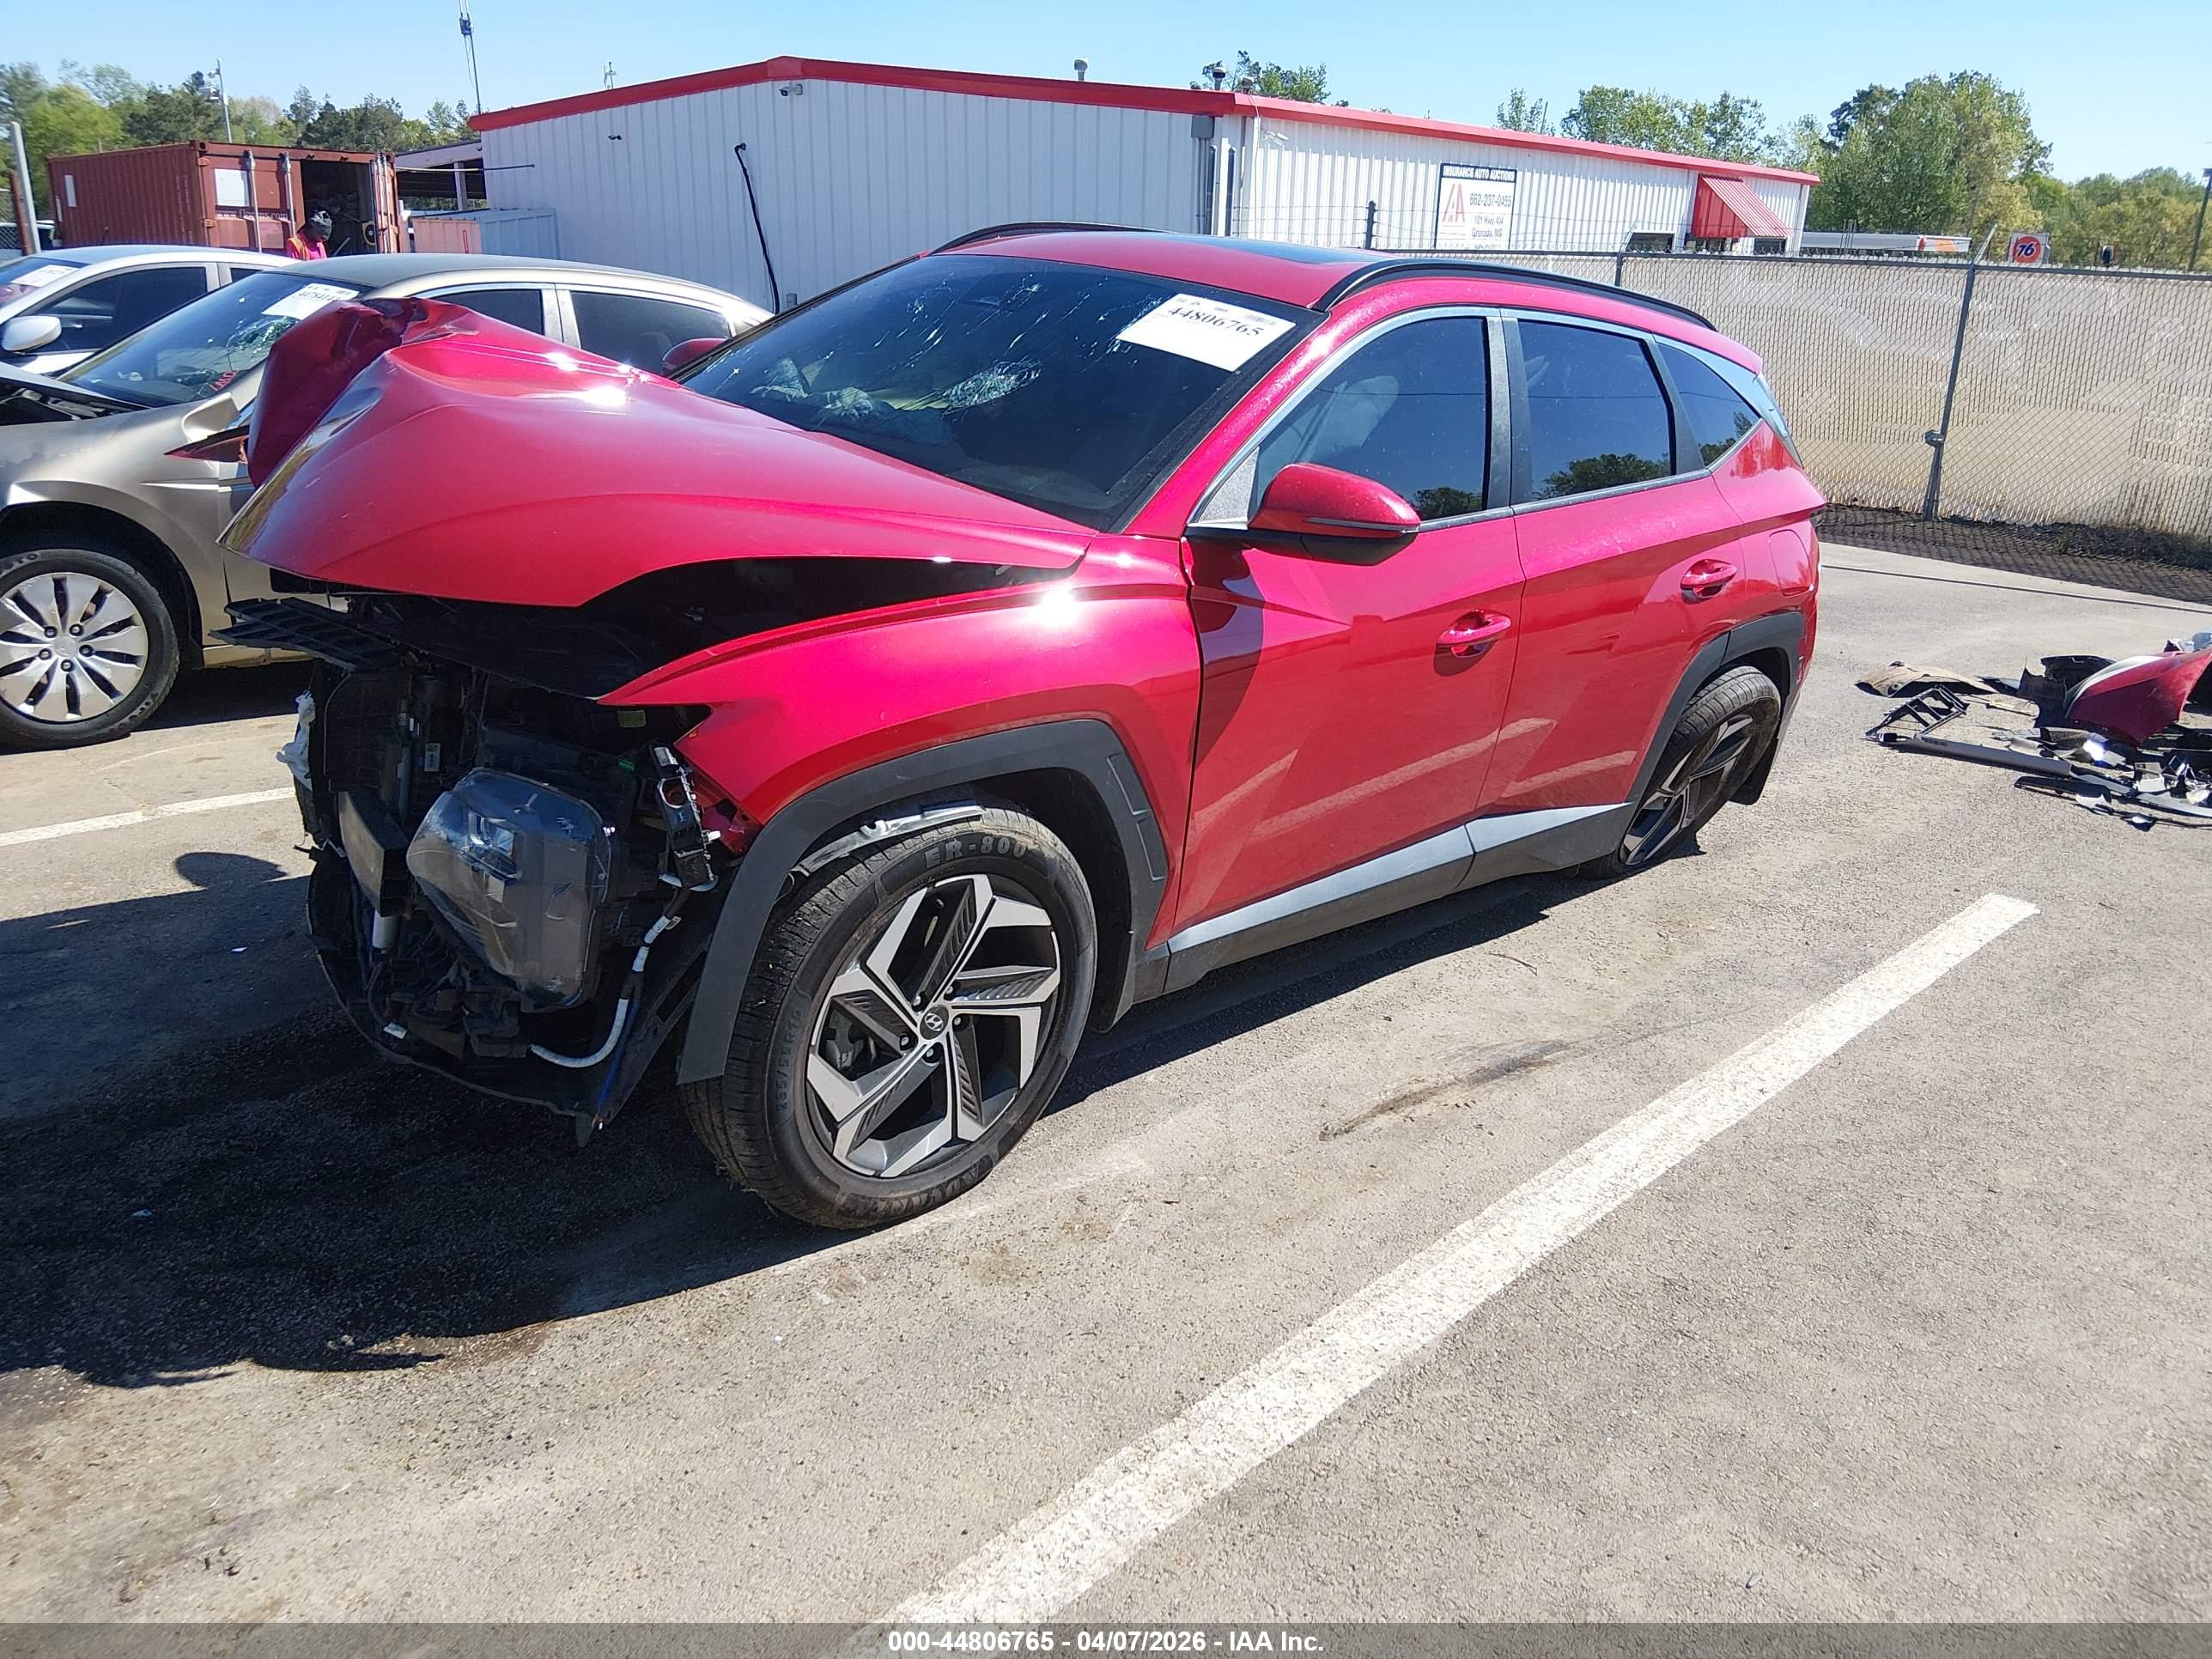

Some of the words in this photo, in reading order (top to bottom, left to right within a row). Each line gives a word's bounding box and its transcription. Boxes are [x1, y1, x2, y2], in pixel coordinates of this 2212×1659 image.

[1443, 164, 1474, 178] INSURANCE
[1474, 167, 1490, 179] AUTO
[1490, 169, 1516, 182] AUCTIONS
[2017, 241, 2036, 257] 76
[1167, 307, 1265, 336] 44806765
